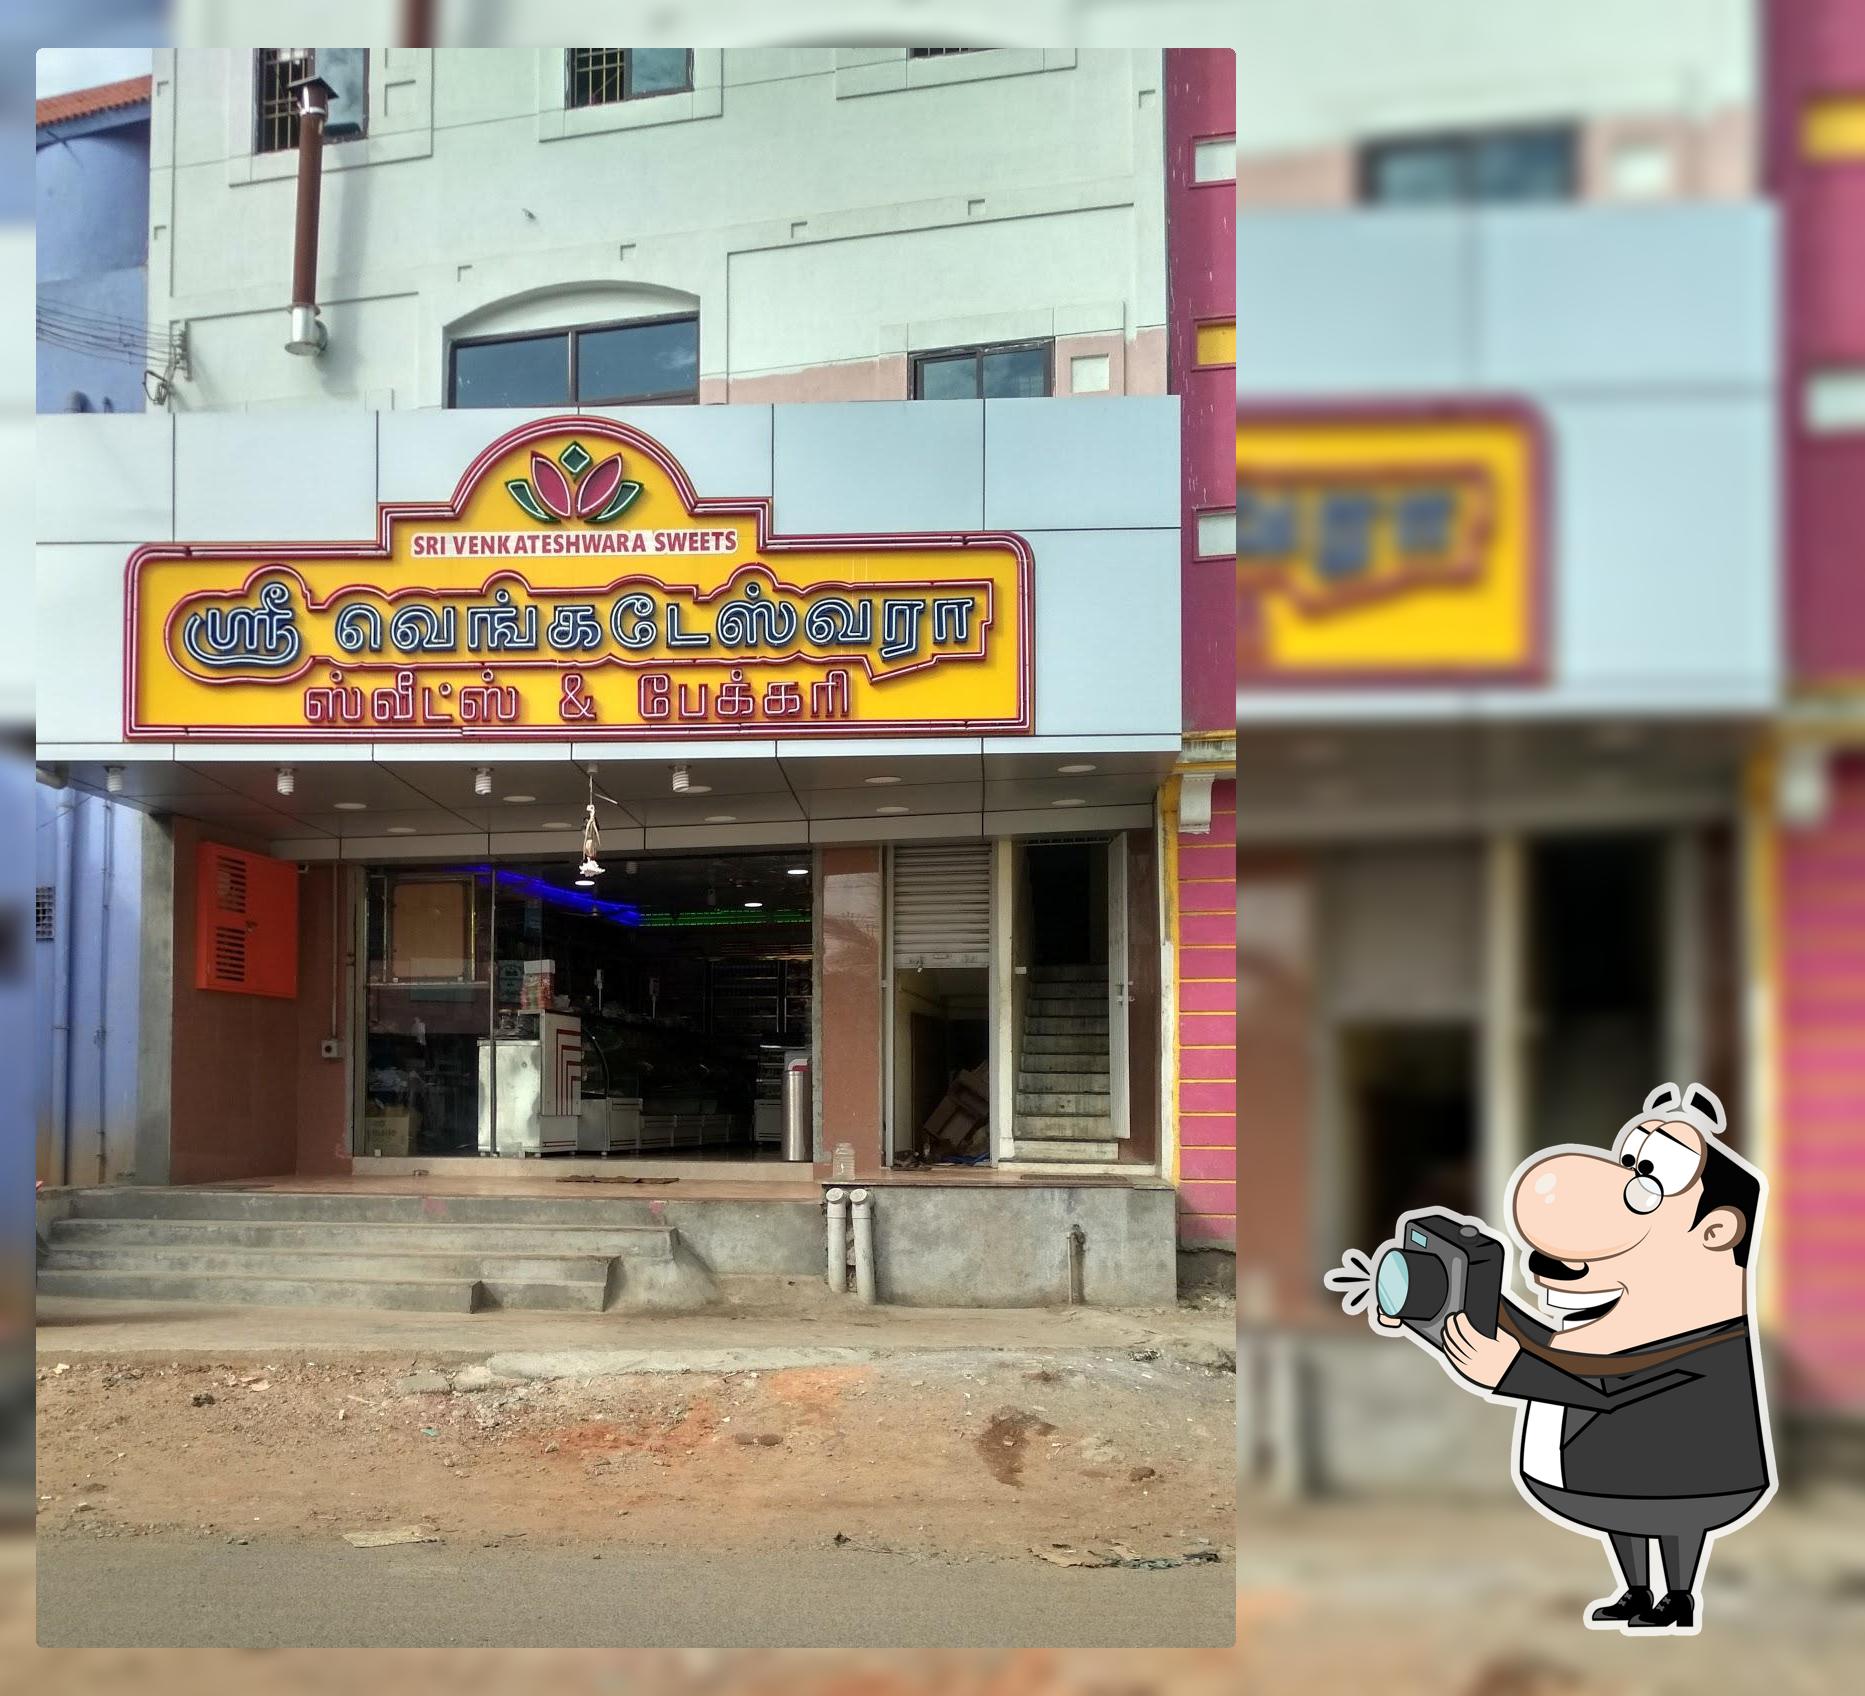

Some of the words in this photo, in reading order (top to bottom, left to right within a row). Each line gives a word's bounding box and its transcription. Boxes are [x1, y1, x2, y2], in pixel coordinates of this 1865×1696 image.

[413, 535, 446, 556] SRI
[452, 532, 647, 555] VENKATESHWARA
[654, 530, 737, 551] SWEETS
[334, 581, 976, 664] வெங்கடேஸ்வரா
[303, 668, 521, 722] ஸ்வீட்ஸ்
[559, 671, 597, 722] &
[637, 668, 849, 720] பேக்கரி
